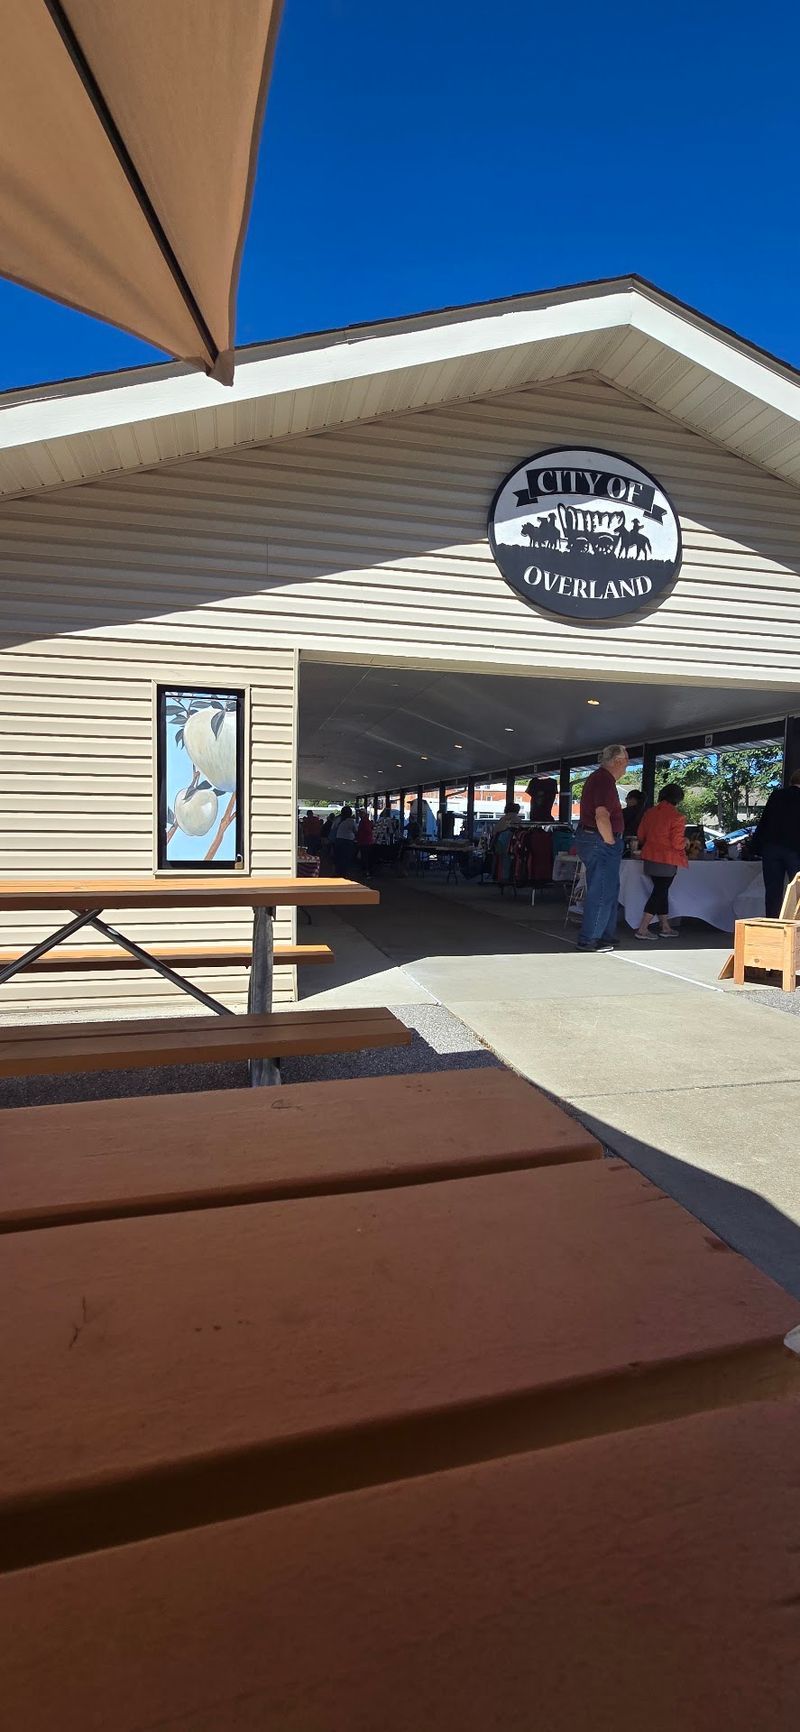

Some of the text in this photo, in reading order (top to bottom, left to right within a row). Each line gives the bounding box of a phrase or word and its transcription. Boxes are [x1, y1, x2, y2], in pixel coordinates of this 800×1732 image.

[537, 470, 643, 503] CITY OF
[523, 565, 653, 600] OVERLAND
